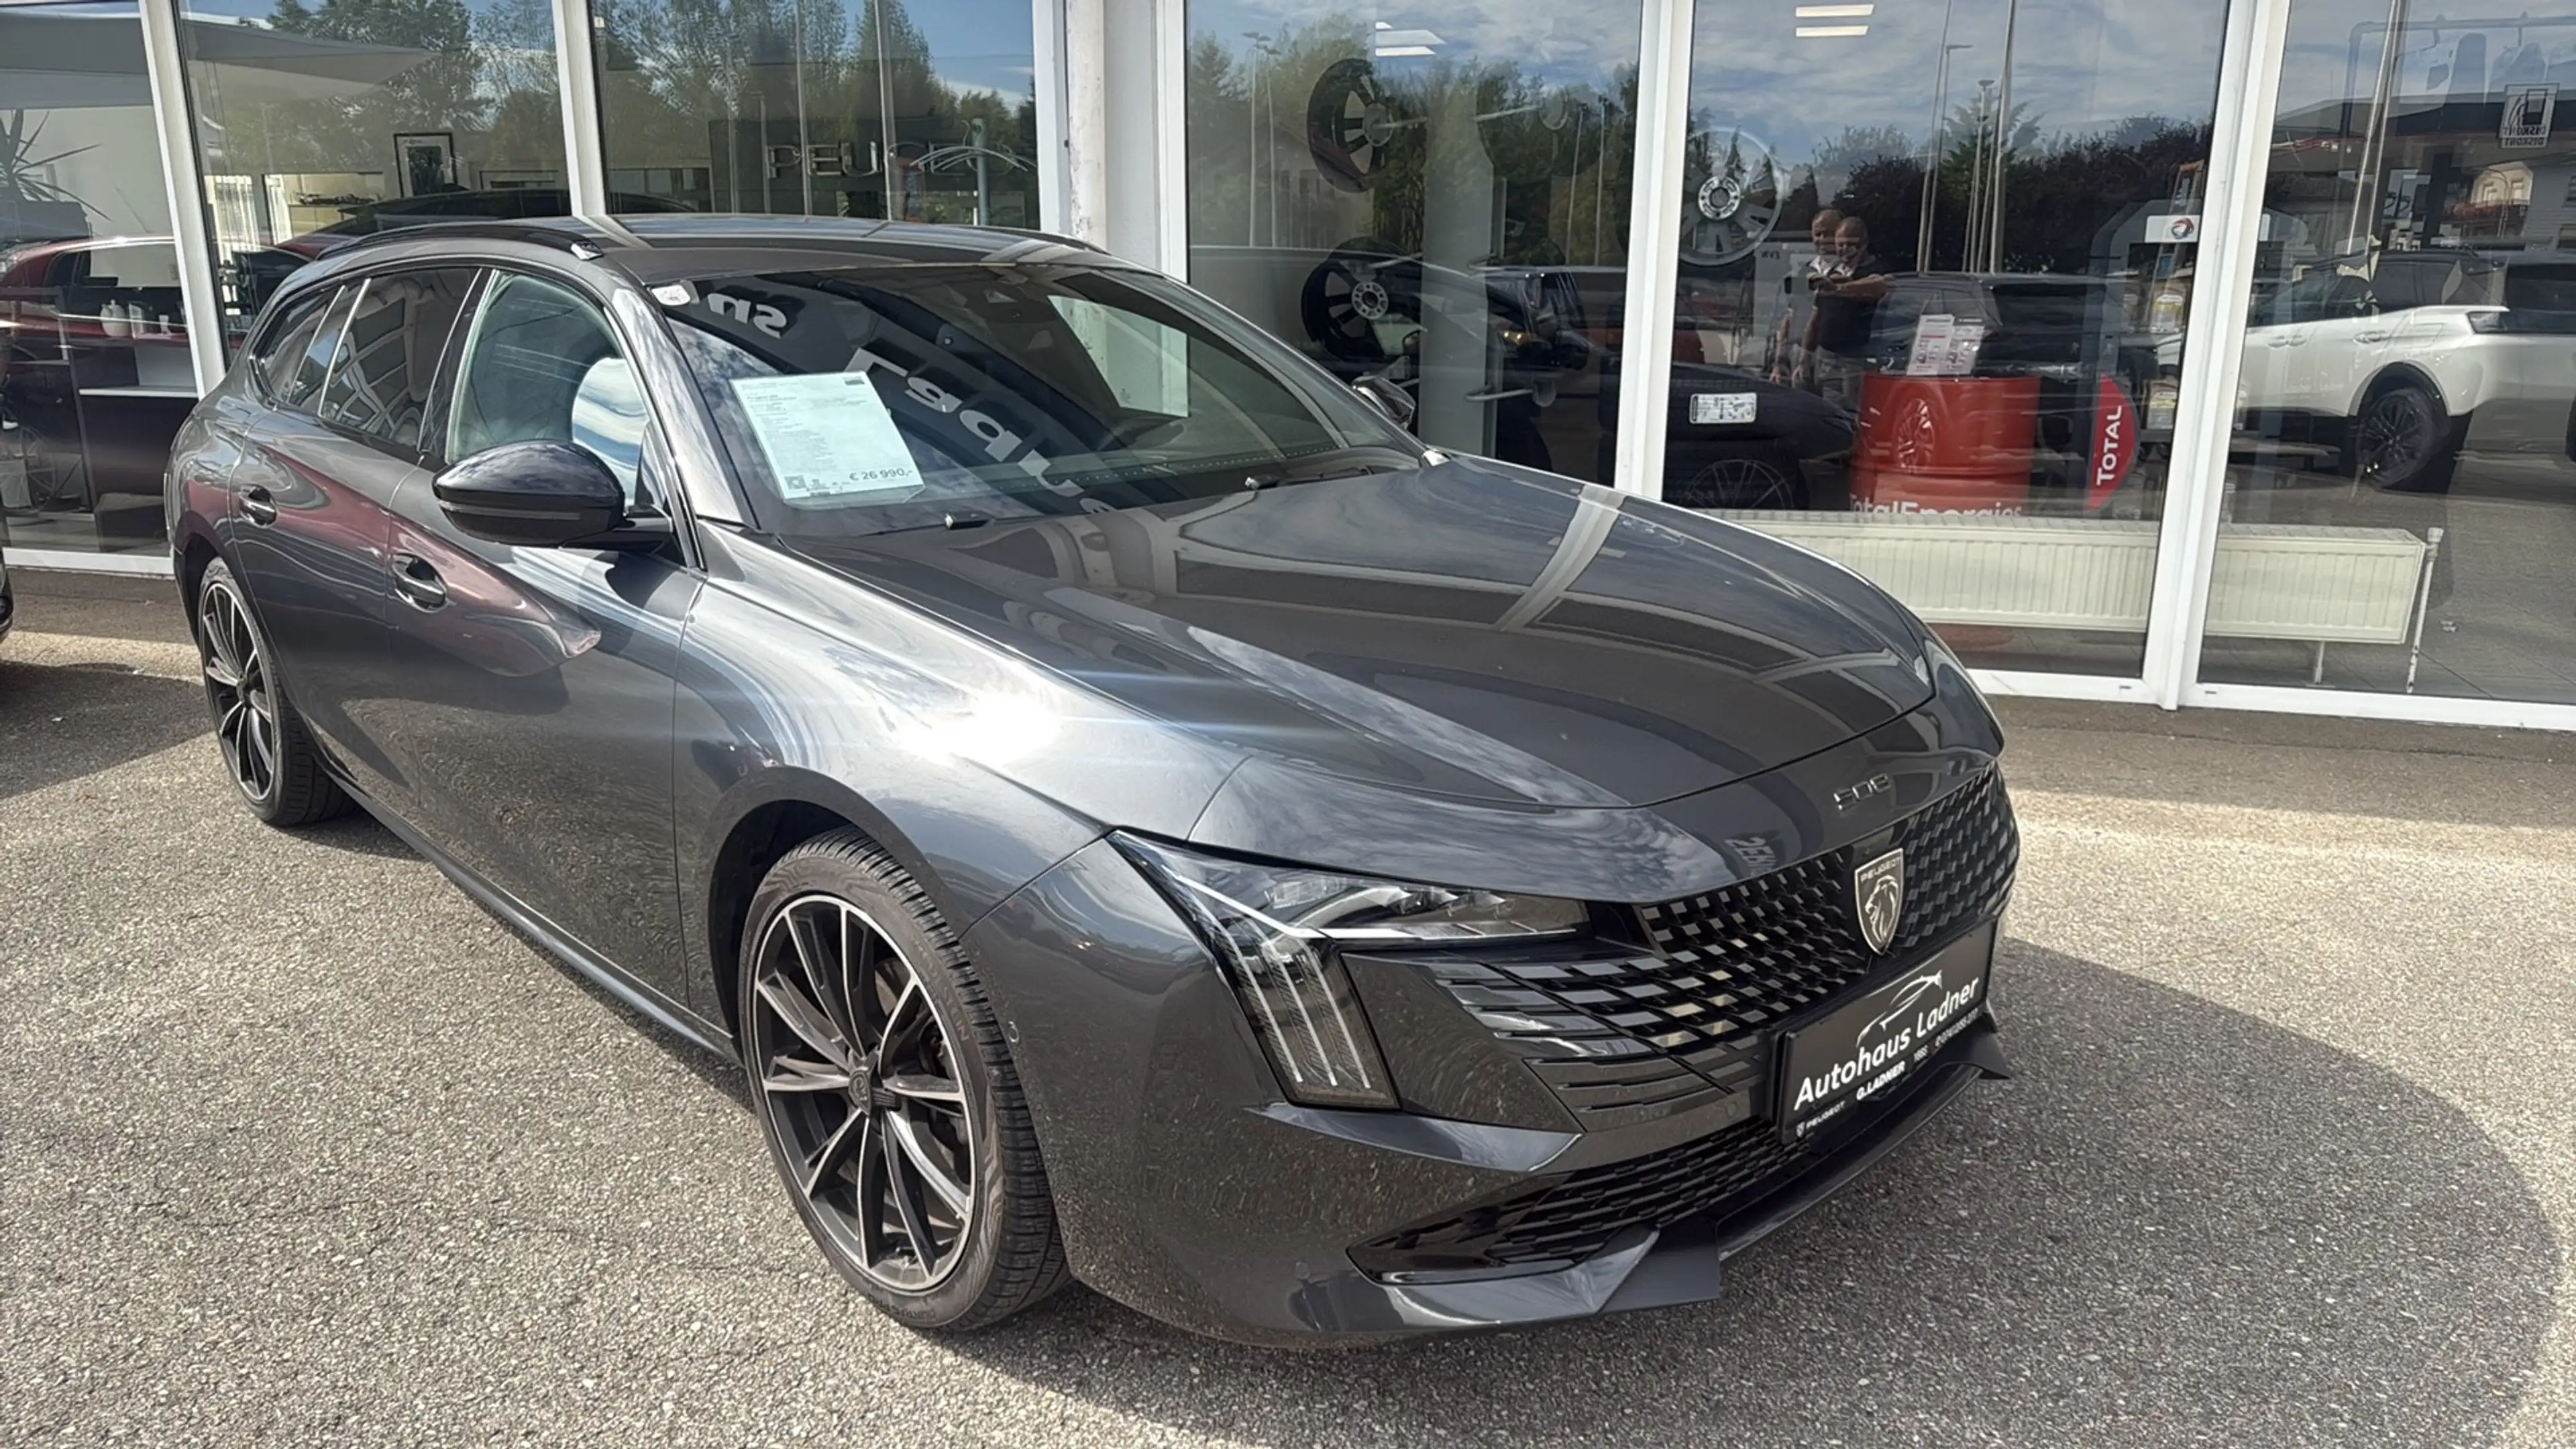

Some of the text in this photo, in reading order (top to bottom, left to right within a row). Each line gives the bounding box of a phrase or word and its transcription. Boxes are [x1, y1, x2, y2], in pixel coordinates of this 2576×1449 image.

[2096, 405, 2123, 486] TOTAL
[861, 471, 877, 480] 26
[1860, 857, 1901, 883] PEUGEOT
[1792, 1026, 1912, 1111] Autohaus
[1915, 976, 1979, 1038] Ladner
[1805, 1100, 1846, 1130] PEUGEOT
